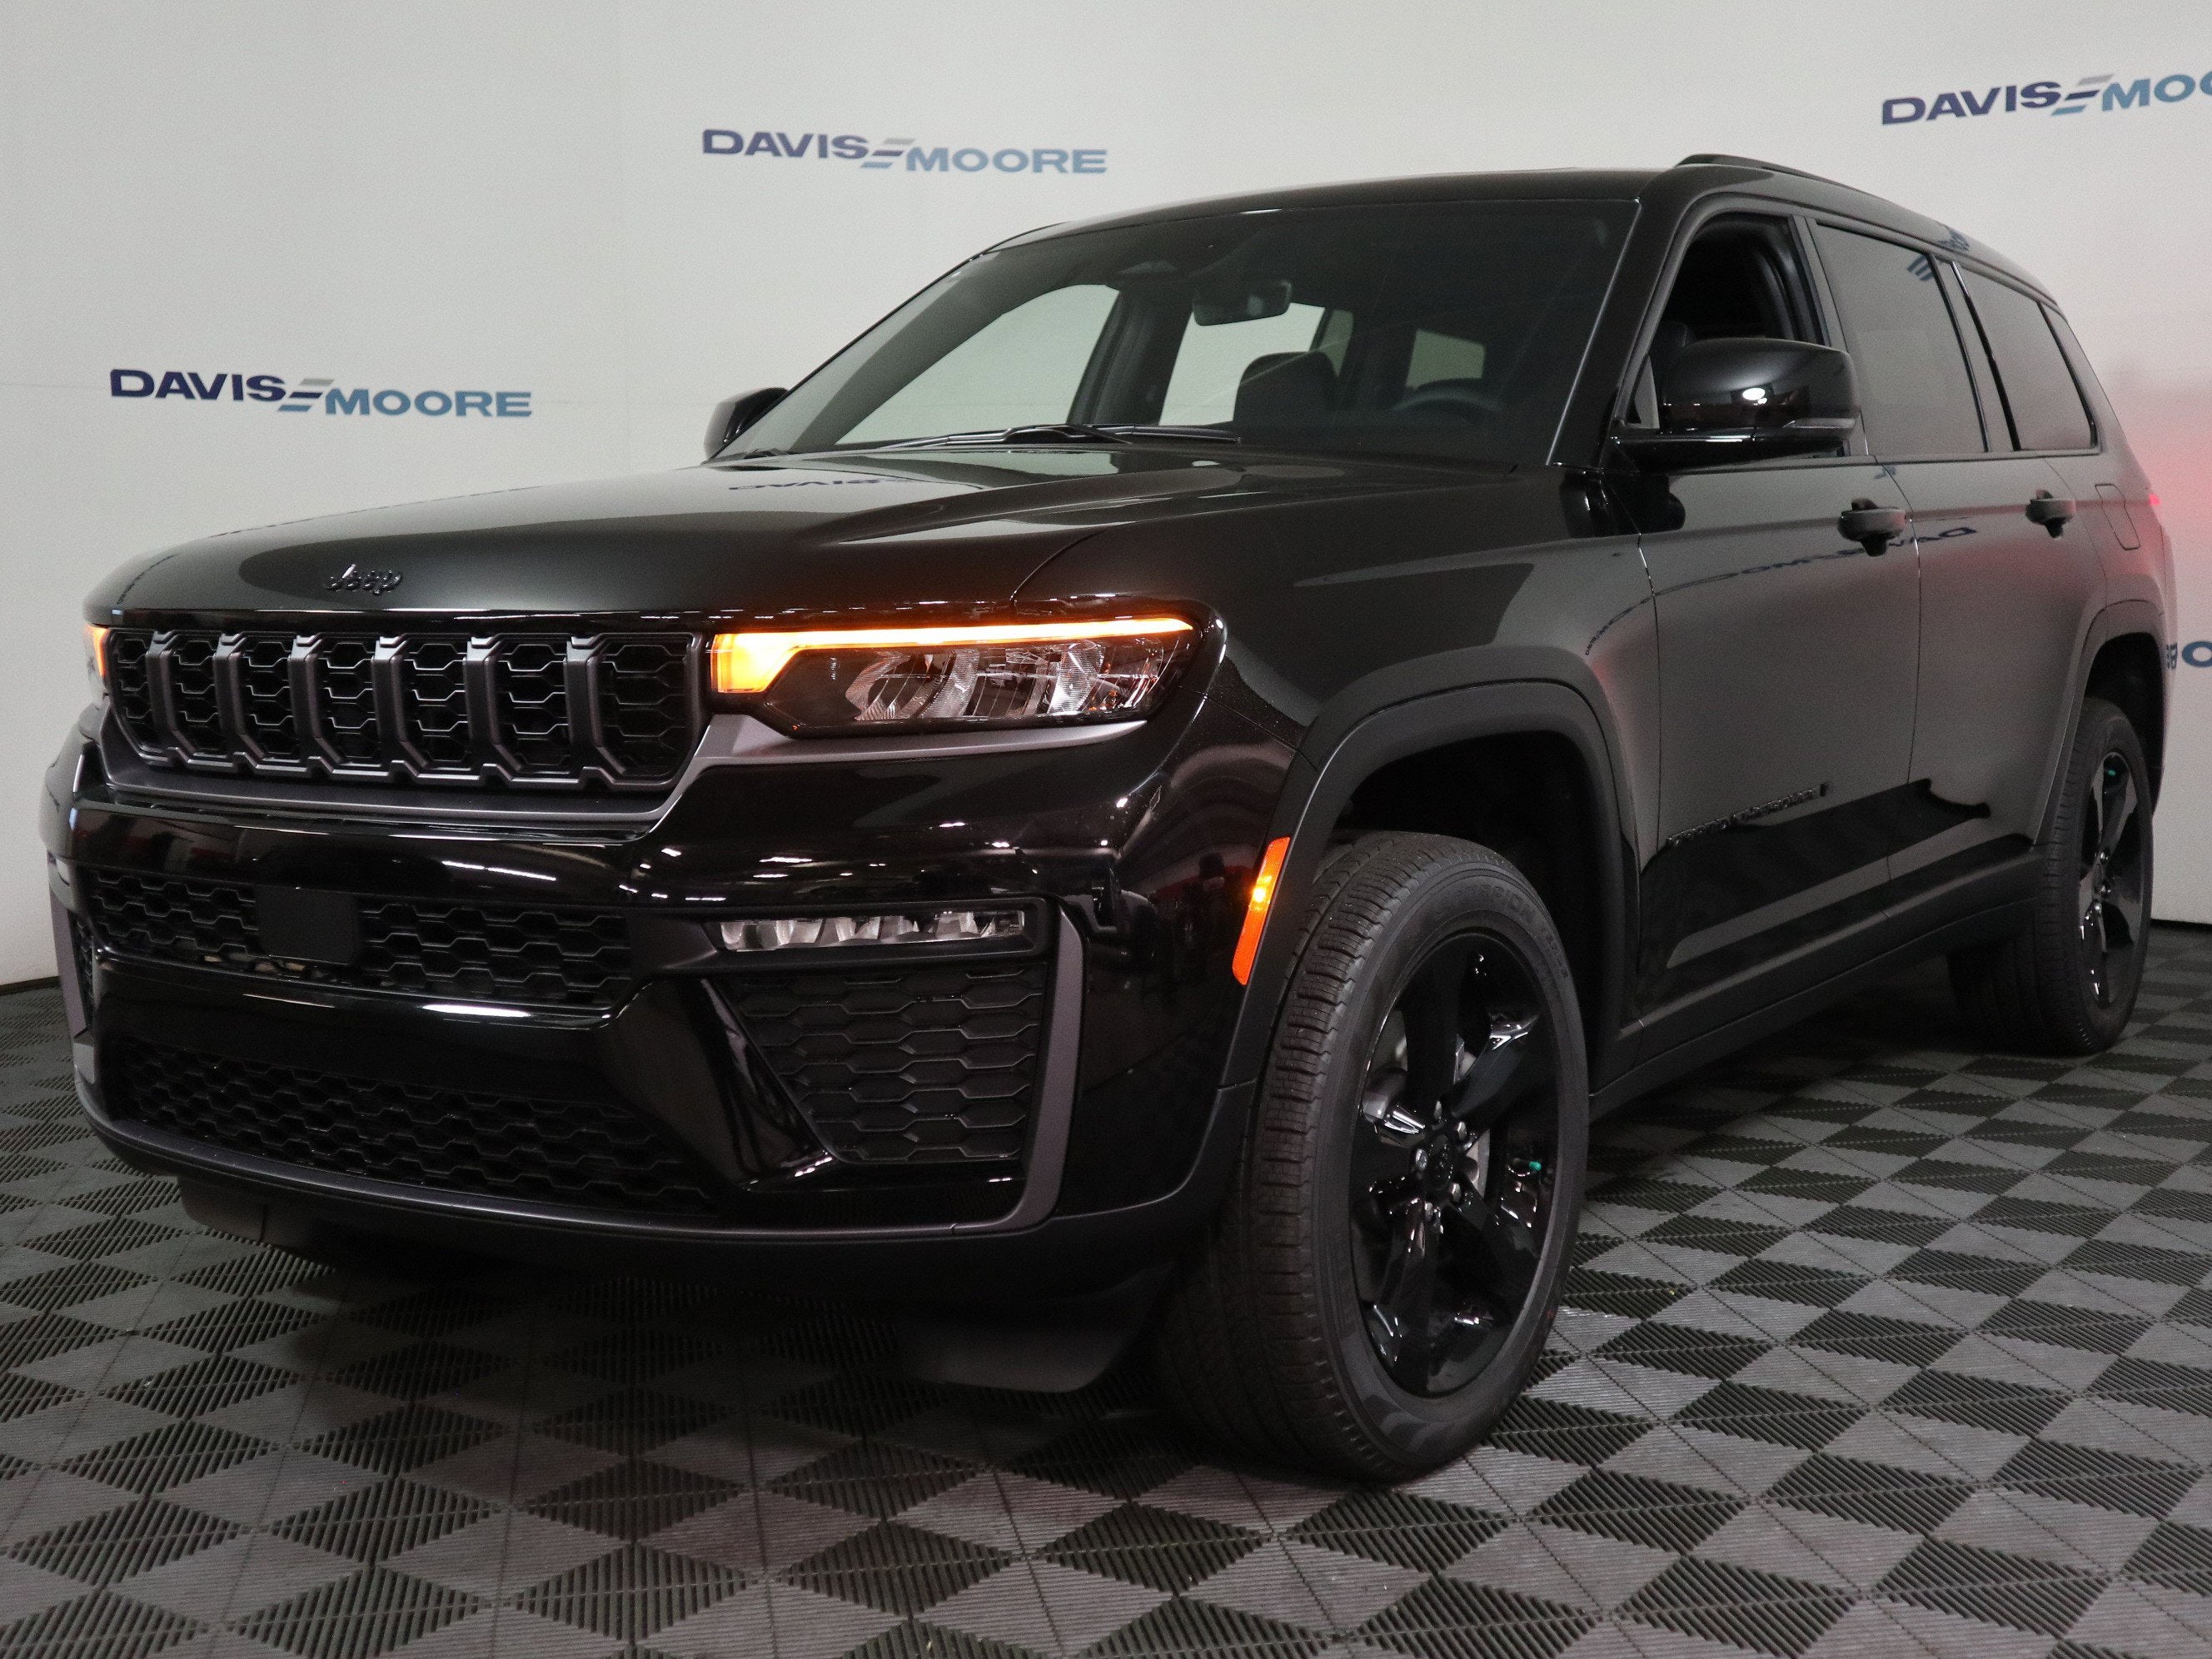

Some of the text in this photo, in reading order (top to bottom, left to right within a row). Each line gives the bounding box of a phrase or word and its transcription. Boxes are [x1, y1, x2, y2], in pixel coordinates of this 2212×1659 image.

[1881, 81, 2061, 126] DAVIS
[701, 128, 1108, 174] DAVIS MOORE
[109, 368, 531, 417] DAVIS MOORE
